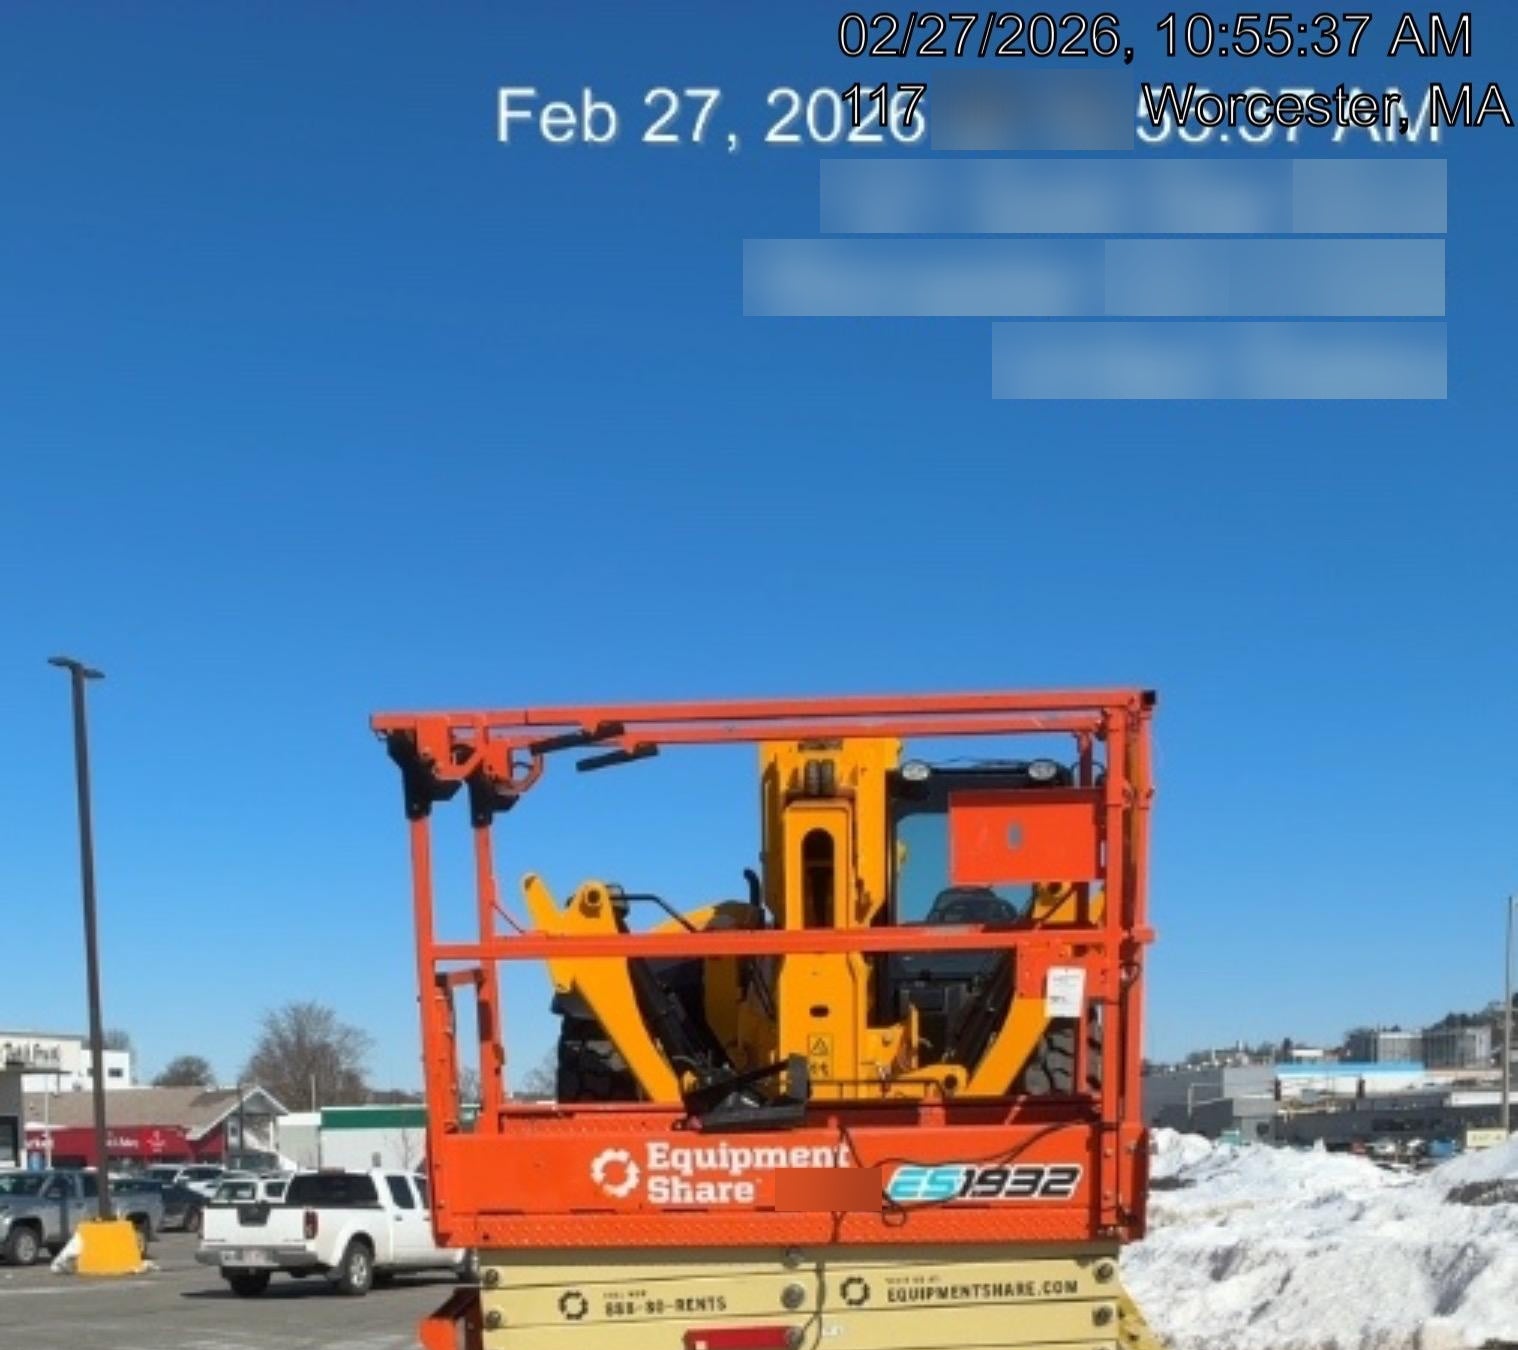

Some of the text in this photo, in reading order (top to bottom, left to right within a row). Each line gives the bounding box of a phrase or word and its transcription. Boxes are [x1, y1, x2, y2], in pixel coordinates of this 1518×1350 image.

[646, 1141, 850, 1177] Equipment
[647, 1175, 755, 1205] Share
[888, 1166, 1082, 1200] ES1932
[887, 1279, 1079, 1304] EQUIPMENTSHARE.COM
